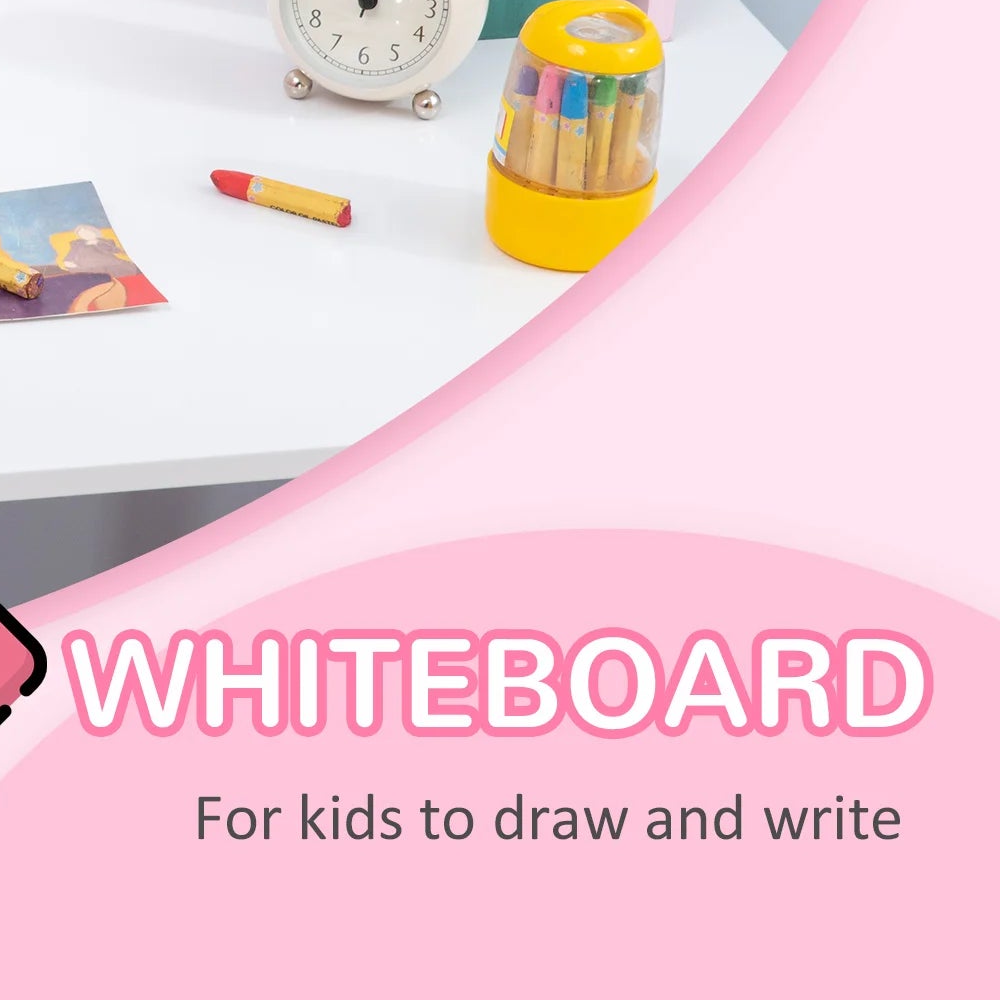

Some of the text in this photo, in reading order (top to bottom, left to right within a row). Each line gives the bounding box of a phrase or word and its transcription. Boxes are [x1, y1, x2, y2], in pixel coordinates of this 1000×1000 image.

[309, 9, 322, 28] 8
[330, 33, 343, 51] 7
[413, 26, 425, 43] 4
[358, 46, 369, 64] 6
[390, 44, 400, 61] 5
